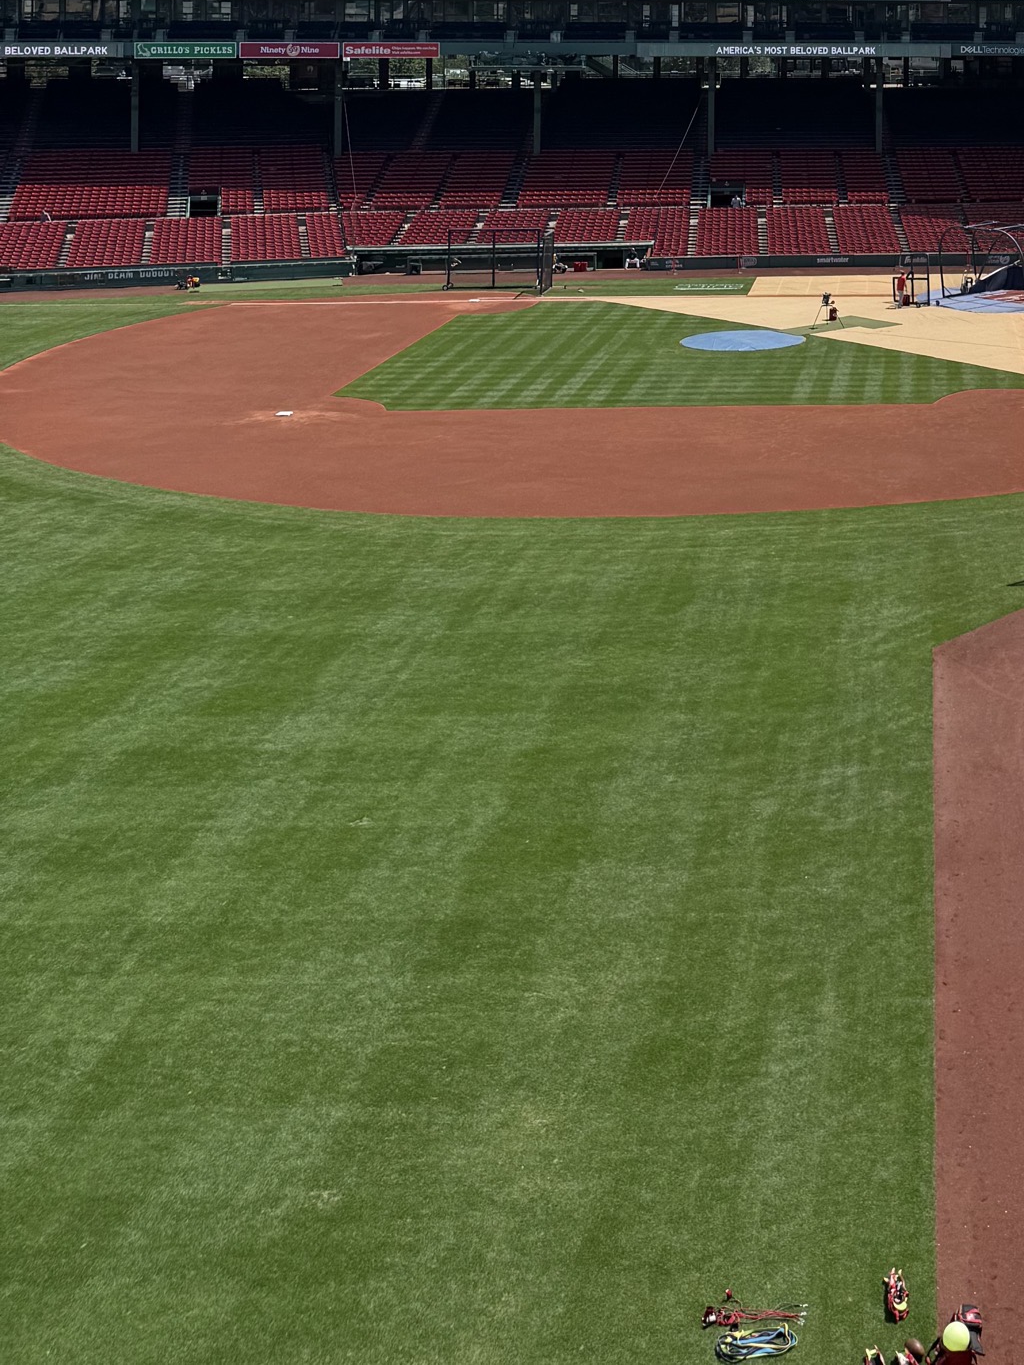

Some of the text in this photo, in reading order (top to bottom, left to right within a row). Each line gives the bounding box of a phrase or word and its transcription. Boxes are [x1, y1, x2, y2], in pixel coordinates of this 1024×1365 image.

[4, 46, 108, 55] BELOVED BALLPARK
[150, 45, 233, 54] GRILLO'S PICKLES
[260, 46, 286, 54] Ninety
[301, 46, 319, 54] Nine
[345, 46, 391, 54] Safelite
[716, 46, 876, 55] AMERICA'S MOST BELOVED BALLPARK
